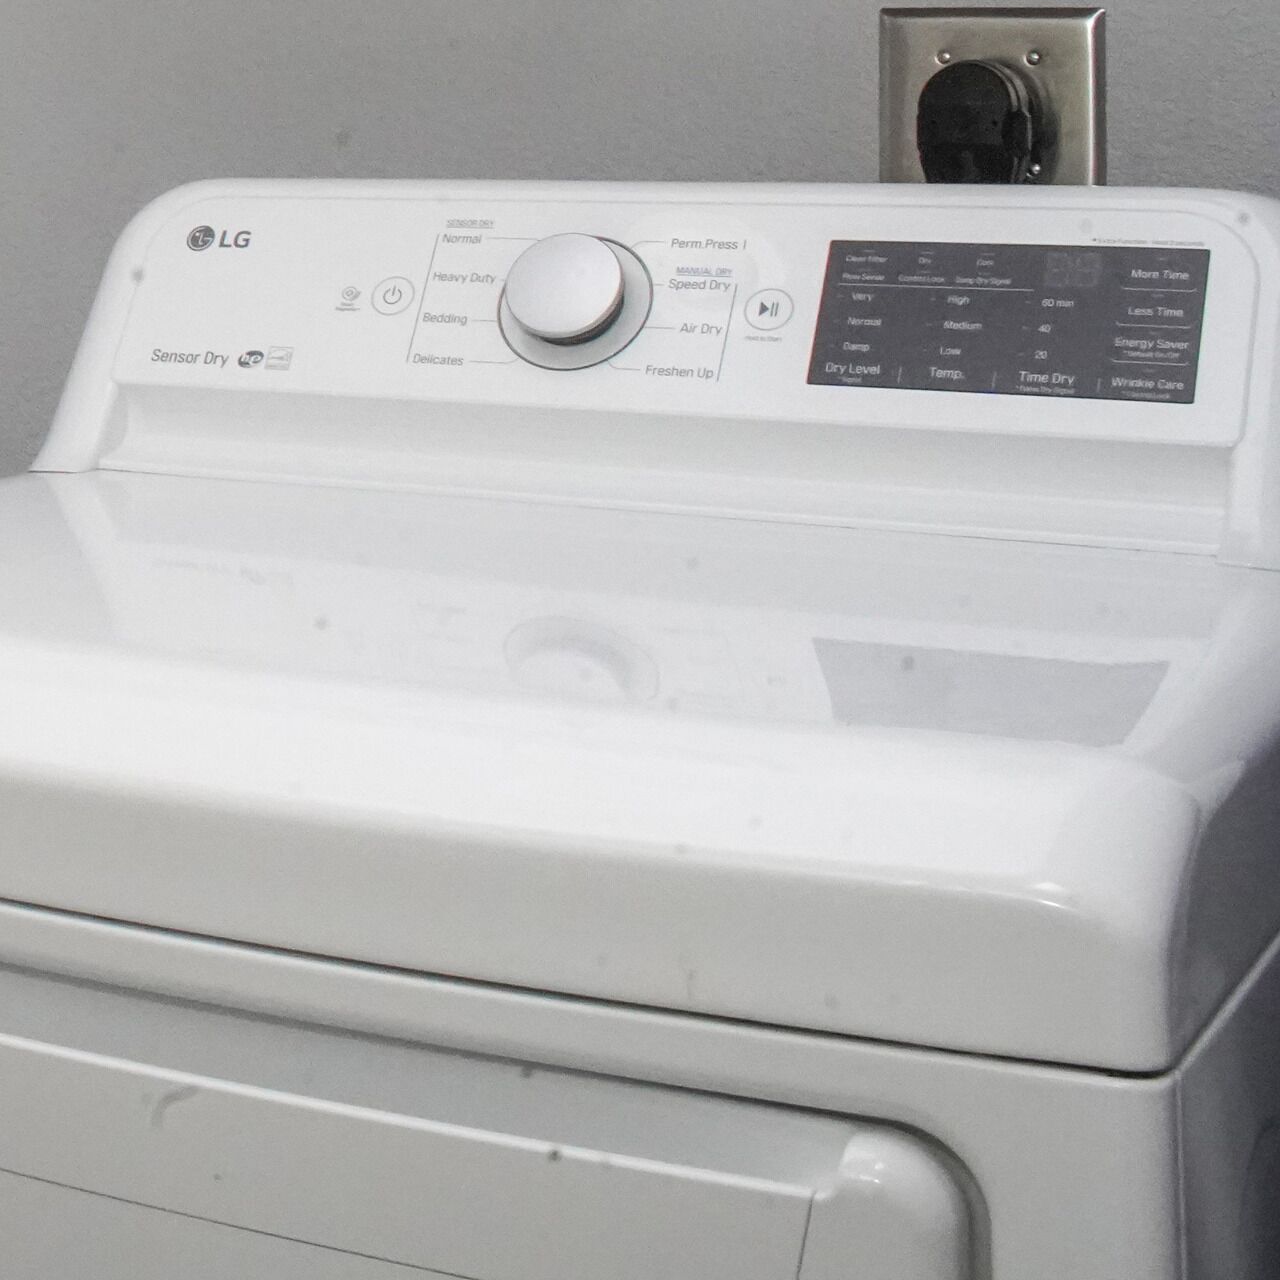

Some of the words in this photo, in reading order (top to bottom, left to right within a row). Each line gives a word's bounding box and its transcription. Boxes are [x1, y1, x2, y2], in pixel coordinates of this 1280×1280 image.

[218, 230, 251, 248] LG
[442, 233, 482, 244] Normal
[433, 272, 466, 285] Heavy
[470, 273, 496, 285] Duty
[1131, 269, 1159, 279] More
[1163, 270, 1189, 280] Time
[668, 279, 706, 290] Speed
[709, 279, 731, 292] Dry
[947, 295, 970, 306] High
[1128, 306, 1153, 316] Less
[1157, 307, 1184, 317] Time
[422, 312, 468, 325] Bedding
[680, 323, 697, 334] Air
[701, 324, 722, 336] Dry
[1114, 336, 1154, 349] Energy
[1157, 339, 1189, 349] Saver
[940, 346, 961, 355] Low
[151, 348, 201, 364] Sensor
[204, 349, 229, 368] Dry
[412, 354, 464, 366] Delicates
[645, 365, 694, 378] Freshen
[697, 367, 714, 379] Up
[825, 362, 847, 375] Dry
[849, 363, 881, 375] Level
[930, 366, 965, 381] Temp.
[1019, 371, 1049, 383] Time
[1052, 372, 1075, 386] Dry
[1112, 377, 1155, 389] Wrinkle
[1158, 379, 1184, 391] Care
